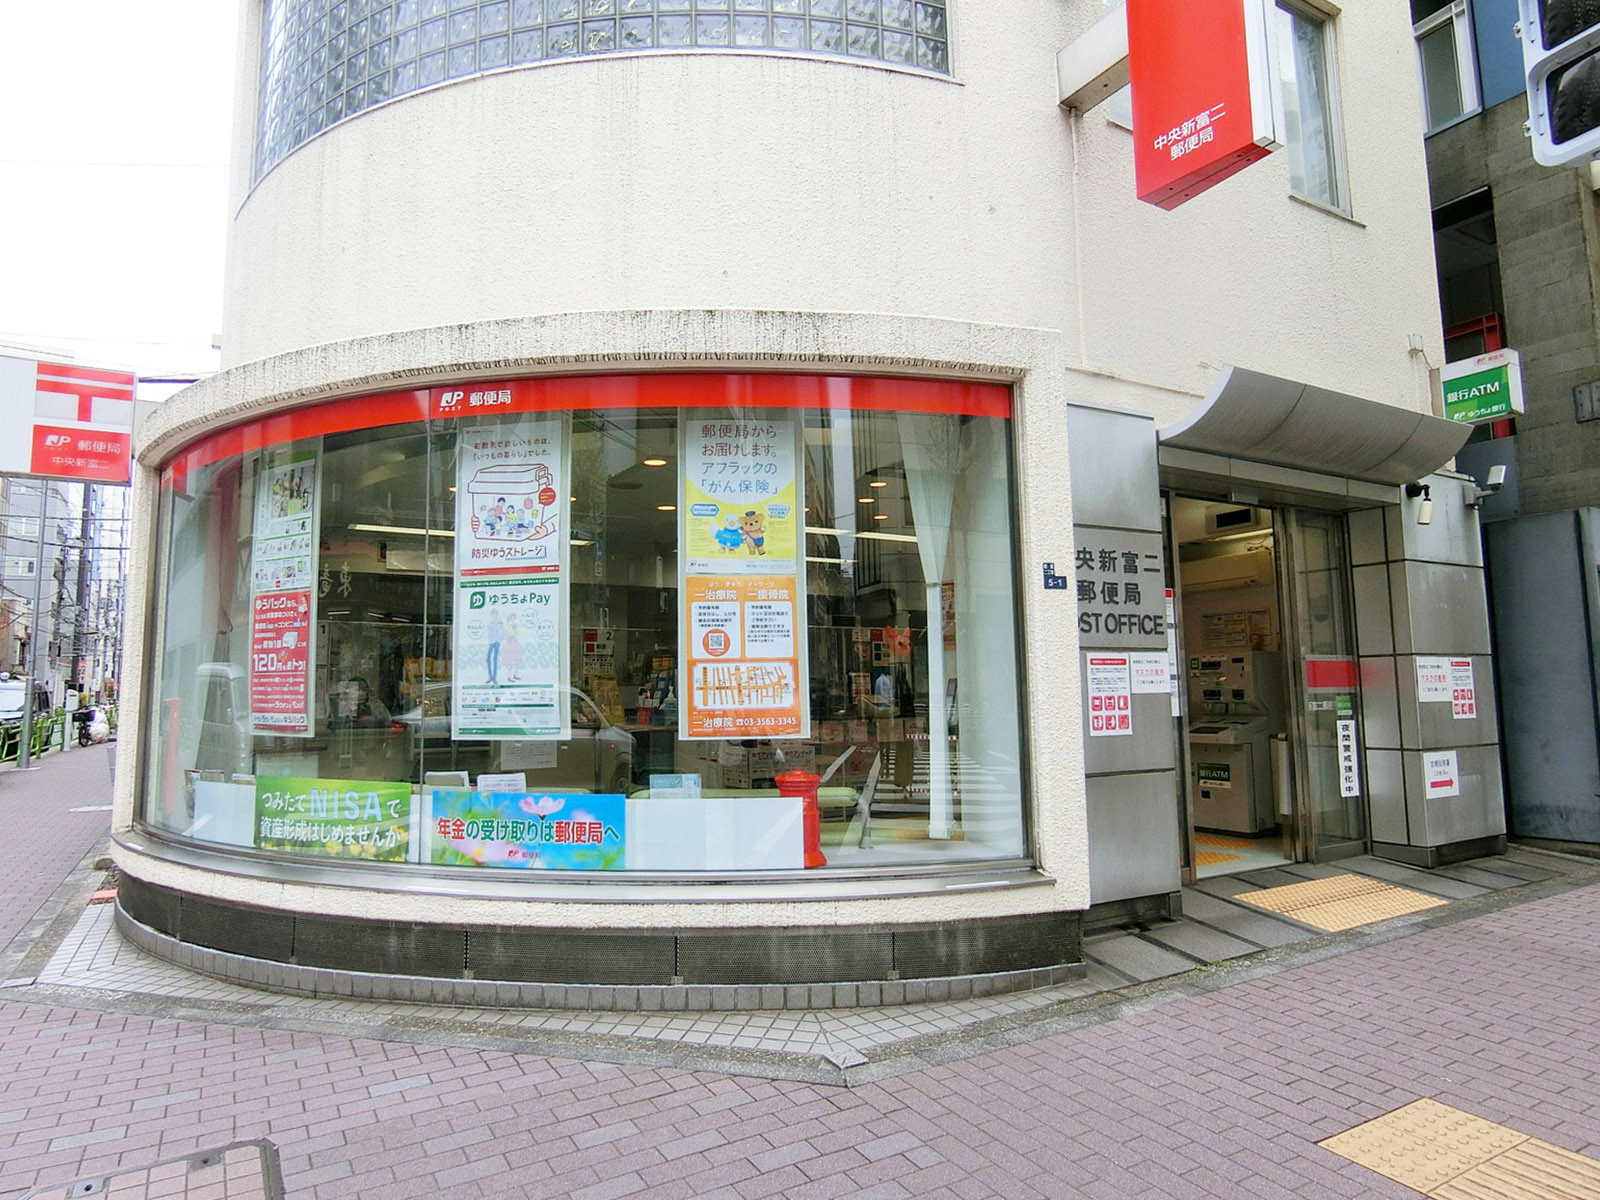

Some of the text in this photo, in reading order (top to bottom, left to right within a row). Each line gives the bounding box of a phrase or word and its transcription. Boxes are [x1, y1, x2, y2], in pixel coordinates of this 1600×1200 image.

[1153, 102, 1227, 151] 中央新富二
[1170, 126, 1215, 161] 郵便局
[469, 390, 511, 406] 郵便局
[1446, 381, 1500, 404] 銀行ATM
[1467, 403, 1506, 418] ゆうちょ銀行
[701, 424, 777, 439] 郵便局から
[77, 439, 121, 454] 郵便局
[701, 442, 778, 458] お届けします。
[51, 456, 110, 469] 中央新富二
[702, 461, 778, 475] アフラックの
[701, 479, 779, 495] 「がん保険」
[471, 545, 544, 559] 防災ゆうストレージ
[489, 592, 551, 606] ゆうちょPay
[1077, 580, 1141, 605] 郵便局
[1078, 612, 1164, 635] ST OFFICE
[743, 717, 796, 726] 03-3563-3345
[260, 816, 401, 848] 資産形成はじめませんか
[437, 816, 621, 846] 年金の受け取りは郵便局へ
